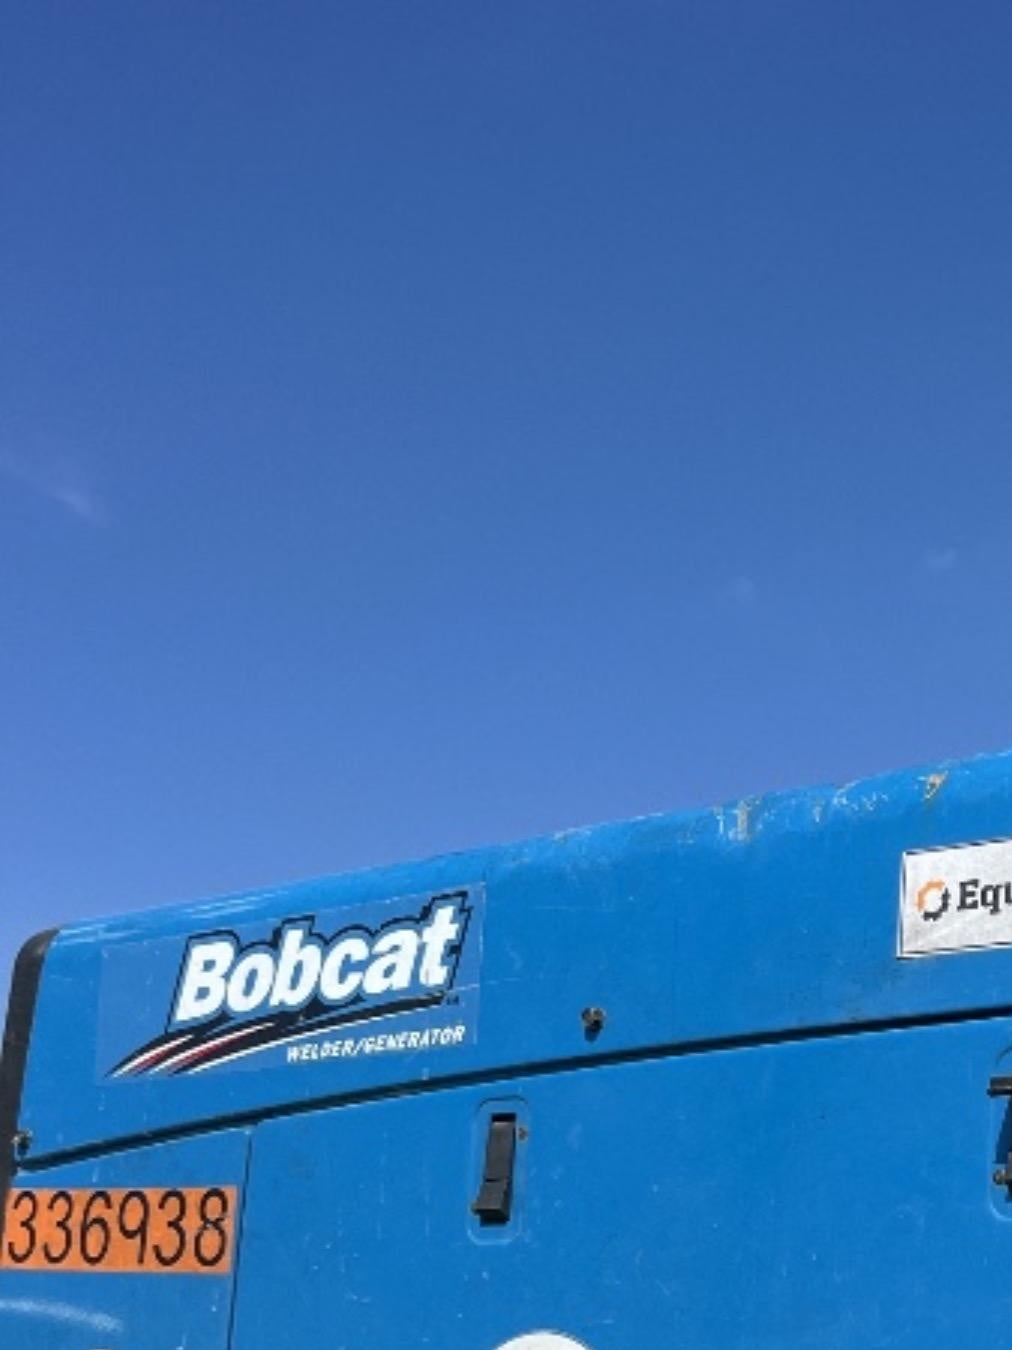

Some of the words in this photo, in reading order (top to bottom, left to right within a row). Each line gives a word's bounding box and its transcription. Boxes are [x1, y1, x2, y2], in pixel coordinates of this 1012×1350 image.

[171, 902, 464, 1026] Bobcat
[286, 1025, 467, 1064] WELDER/GENERATOR
[7, 1187, 231, 1267] 336938
